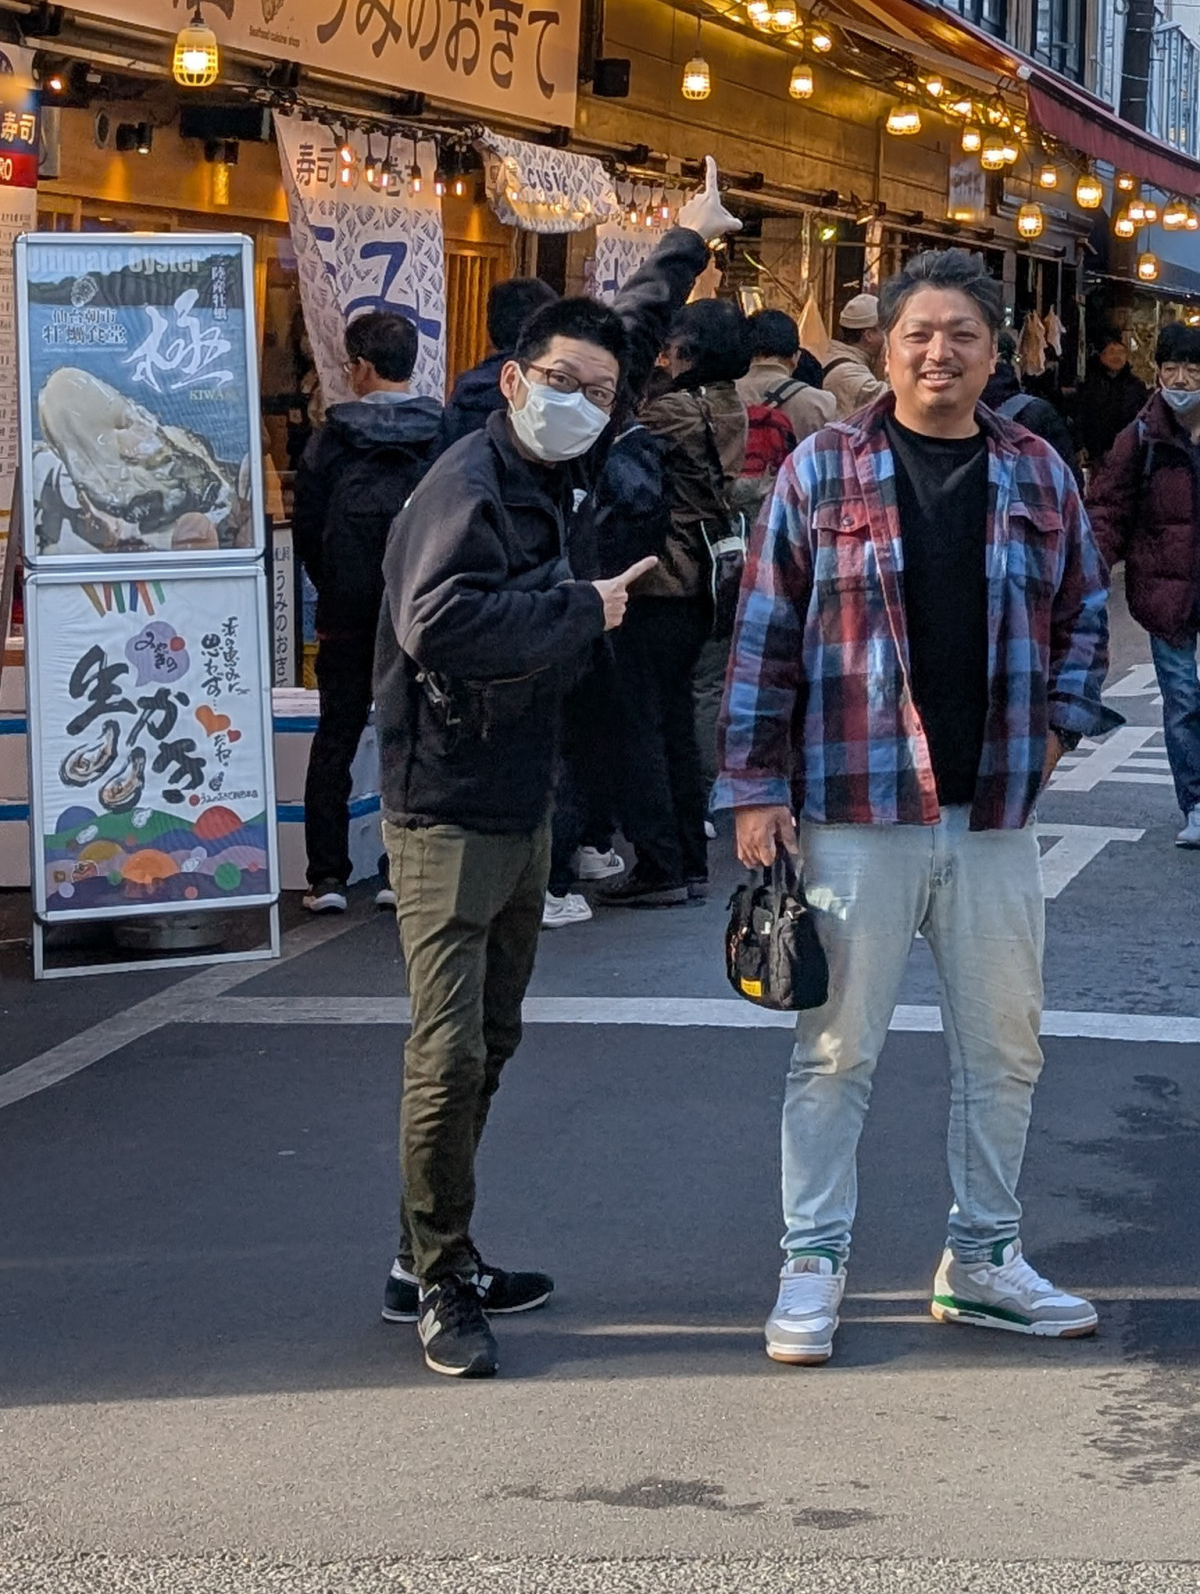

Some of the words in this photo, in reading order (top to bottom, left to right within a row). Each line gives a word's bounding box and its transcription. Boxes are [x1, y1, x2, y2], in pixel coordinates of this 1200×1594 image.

[1, 111, 36, 145] 寿司
[128, 247, 200, 275] Oyster
[52, 308, 117, 324] 仙台朝市
[42, 324, 127, 345] 牡蠣食堂
